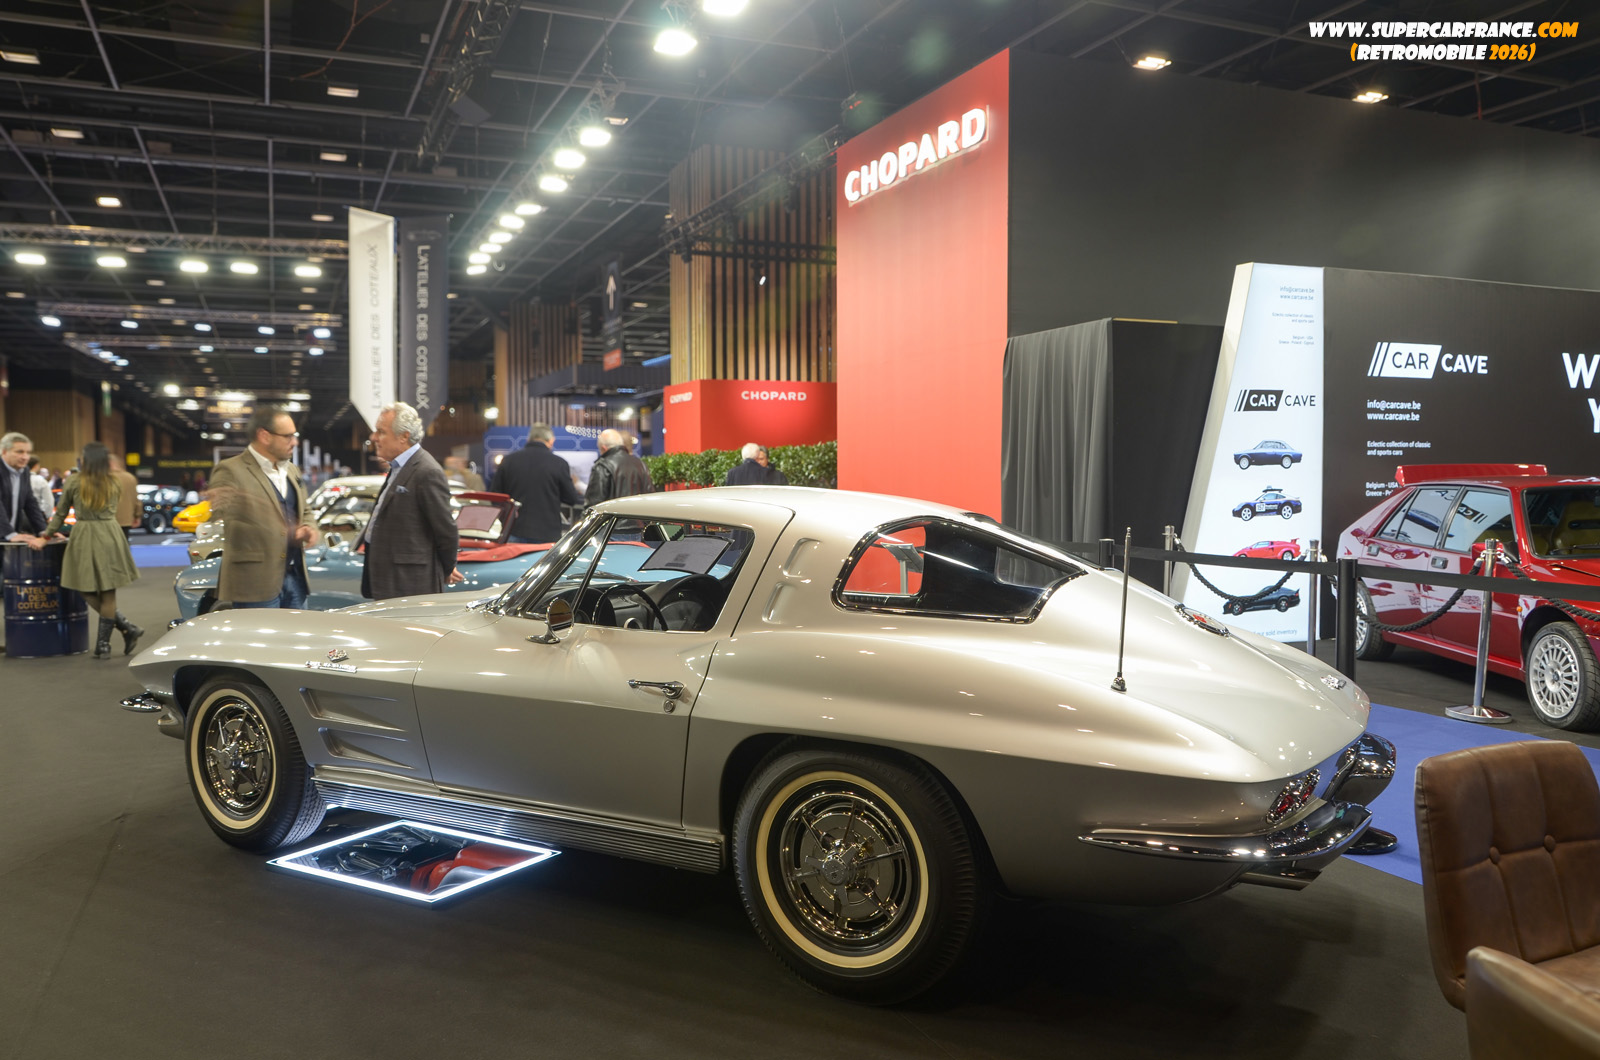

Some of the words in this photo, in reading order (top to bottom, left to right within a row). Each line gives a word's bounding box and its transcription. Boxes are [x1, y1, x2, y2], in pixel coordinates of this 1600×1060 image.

[844, 108, 986, 202] CHOPARD
[416, 313, 429, 342] DES
[1391, 351, 1429, 370] CAR
[1441, 353, 1488, 374] CAVE
[415, 345, 430, 410] COTEAUX
[741, 390, 807, 401] CHOPARD
[1249, 394, 1277, 407] CAR
[1284, 395, 1316, 407] CAVE
[1366, 400, 1421, 411] info@carcave.be
[1366, 412, 1420, 421] www.carcave.be
[1414, 441, 1431, 449] classic
[1365, 482, 1385, 490] Belgium
[28, 594, 48, 602] DES
